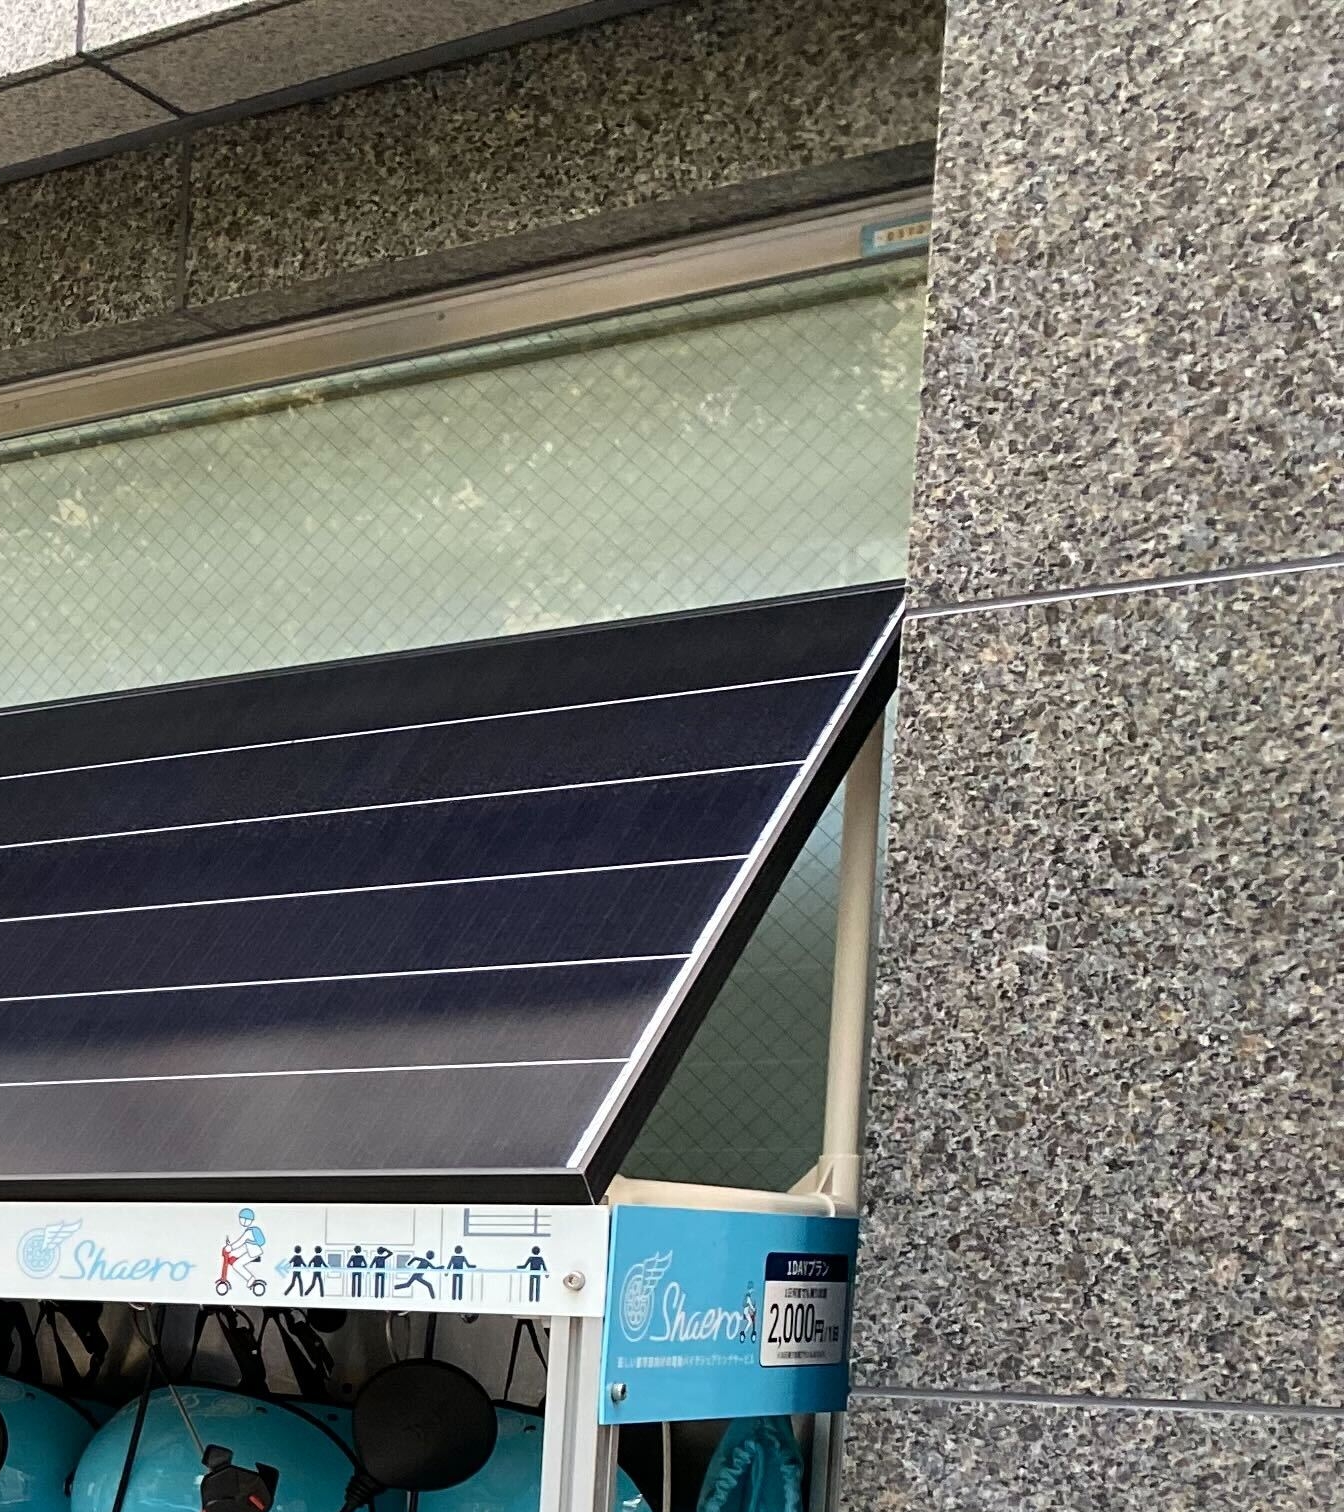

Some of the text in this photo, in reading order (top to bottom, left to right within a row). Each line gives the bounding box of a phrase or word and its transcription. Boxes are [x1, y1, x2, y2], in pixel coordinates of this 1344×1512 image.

[59, 1240, 196, 1281] Shaero
[787, 1260, 830, 1276] 1DAYプラン
[649, 1281, 743, 1342] Shaero
